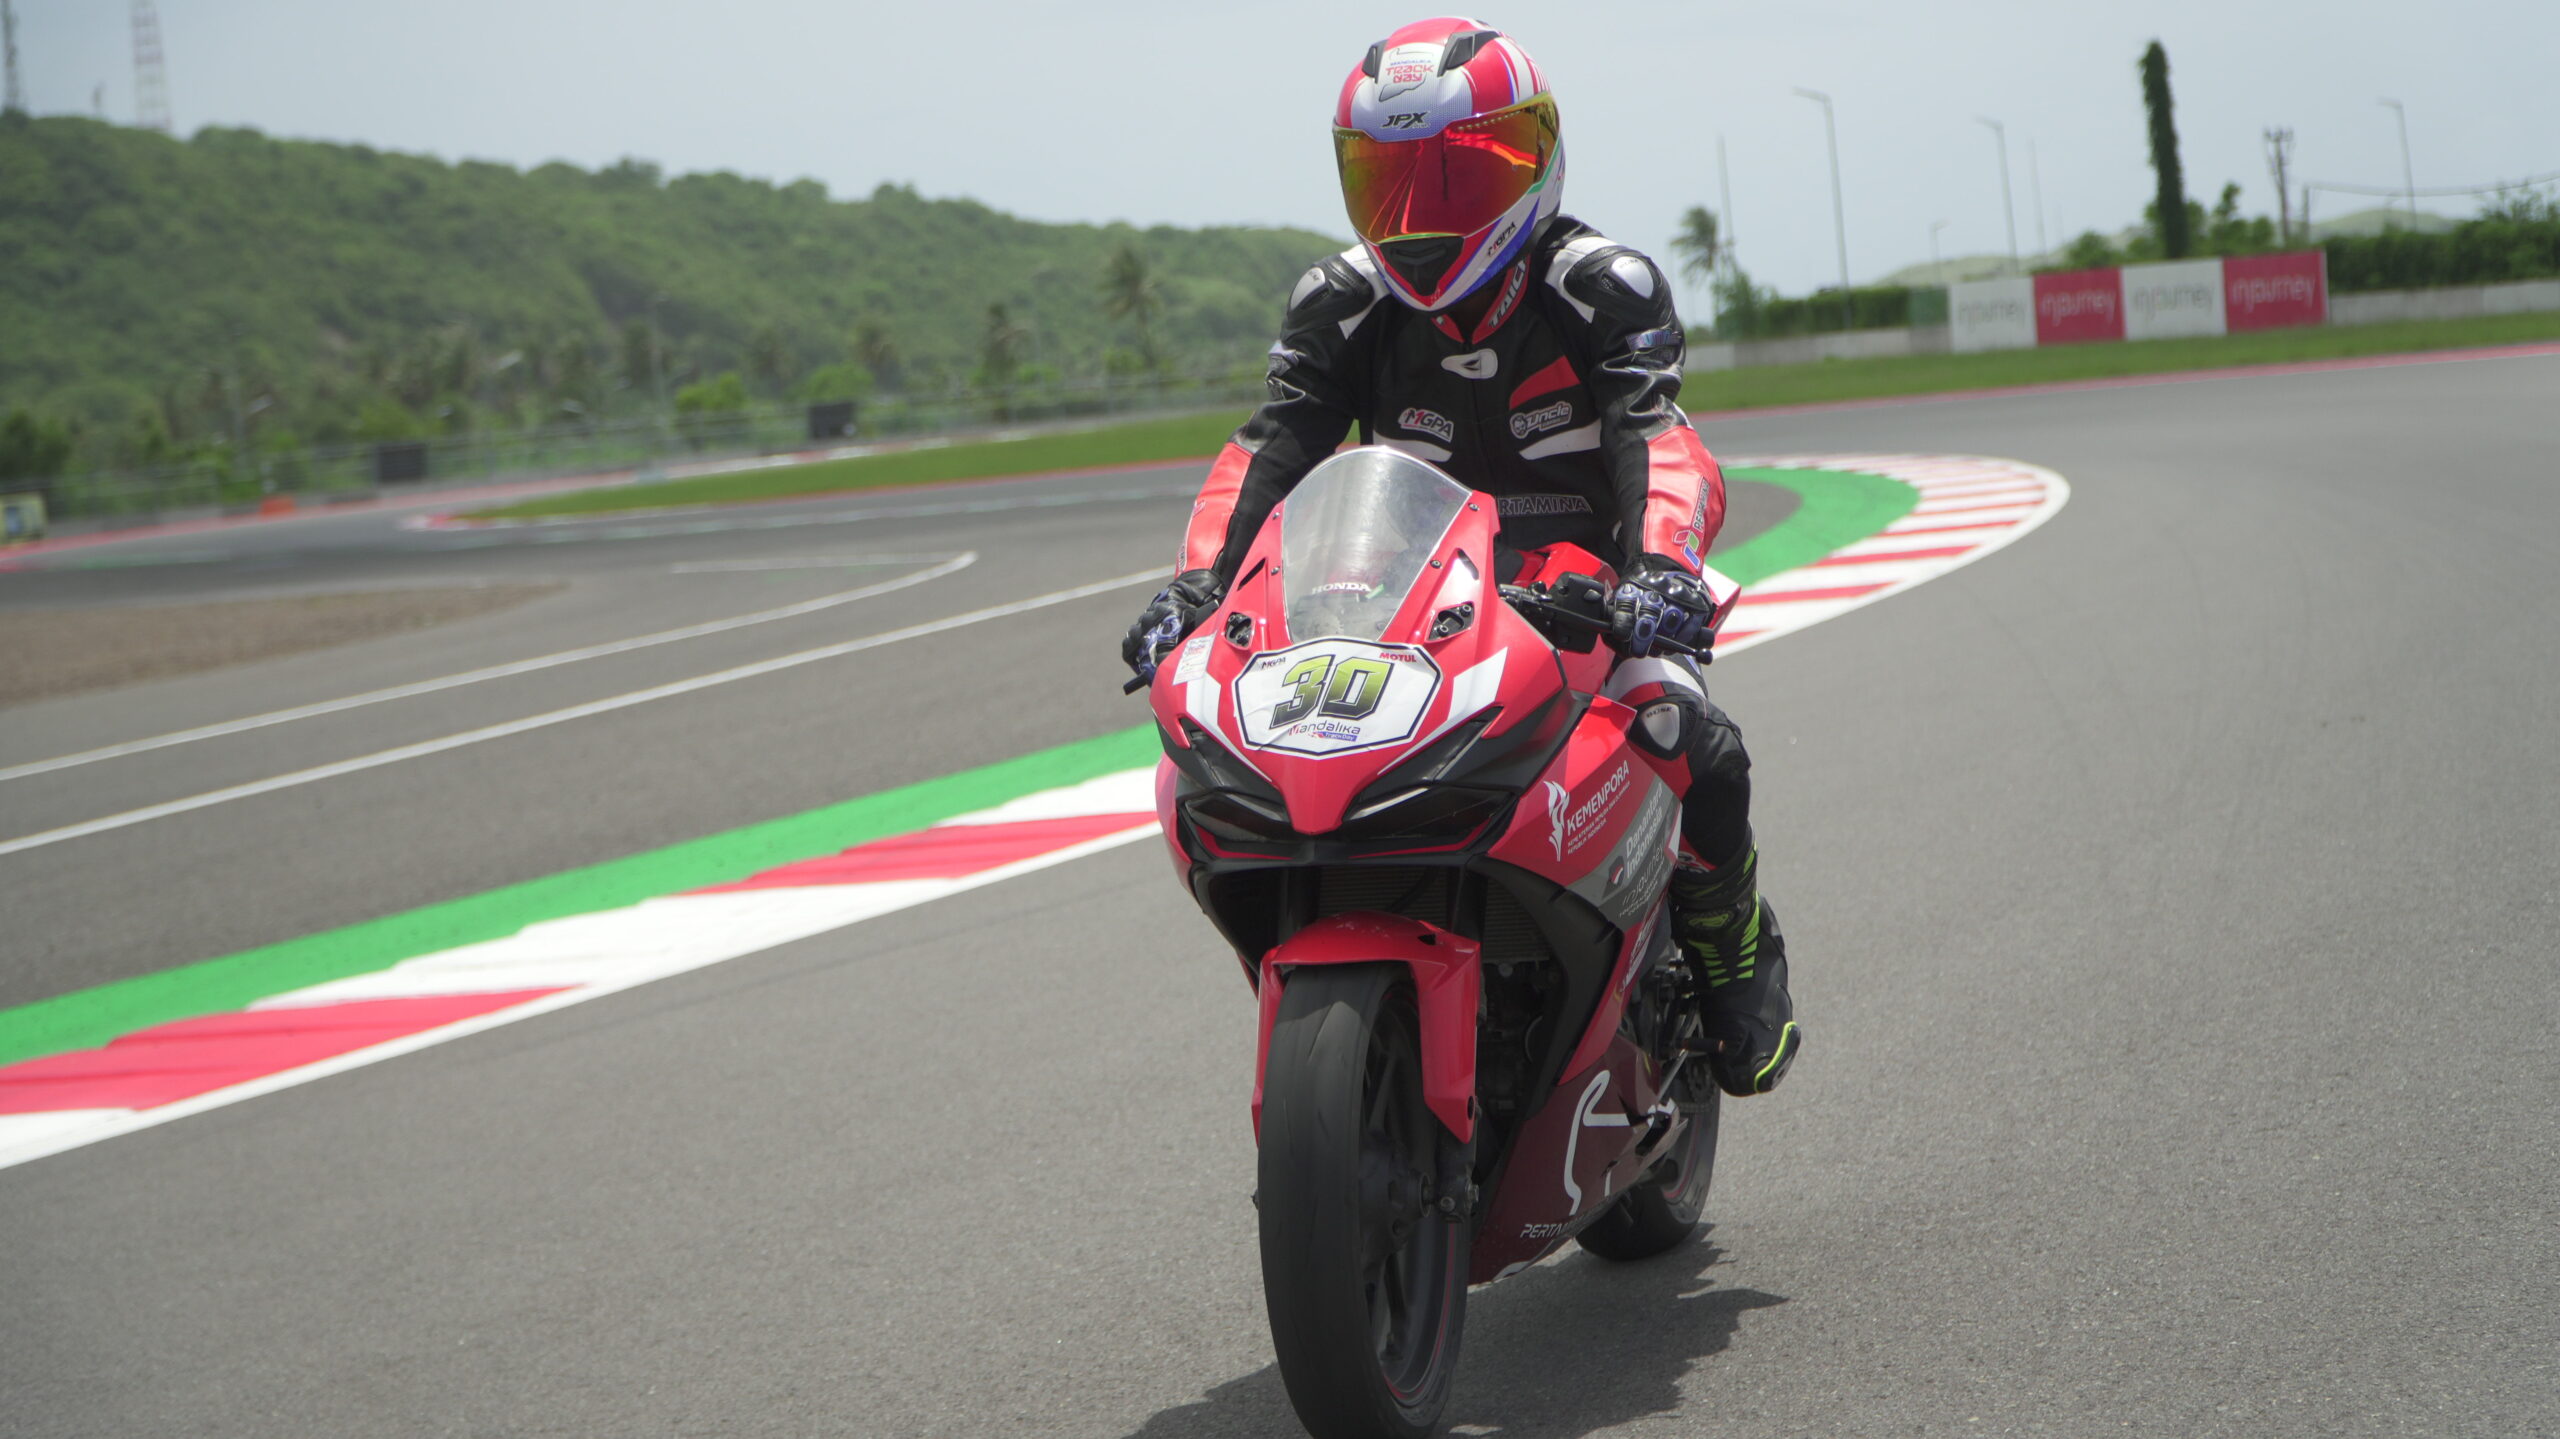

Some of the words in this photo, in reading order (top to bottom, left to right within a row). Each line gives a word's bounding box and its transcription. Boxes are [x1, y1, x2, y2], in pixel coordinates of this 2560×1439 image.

[1382, 111, 1428, 129] JPX
[1499, 496, 1588, 516] RTAMINA
[1311, 581, 1372, 595] HONDA
[1379, 652, 1417, 663] MOTUL
[1269, 654, 1394, 729] 30
[1567, 759, 1630, 837] KEMENPORA
